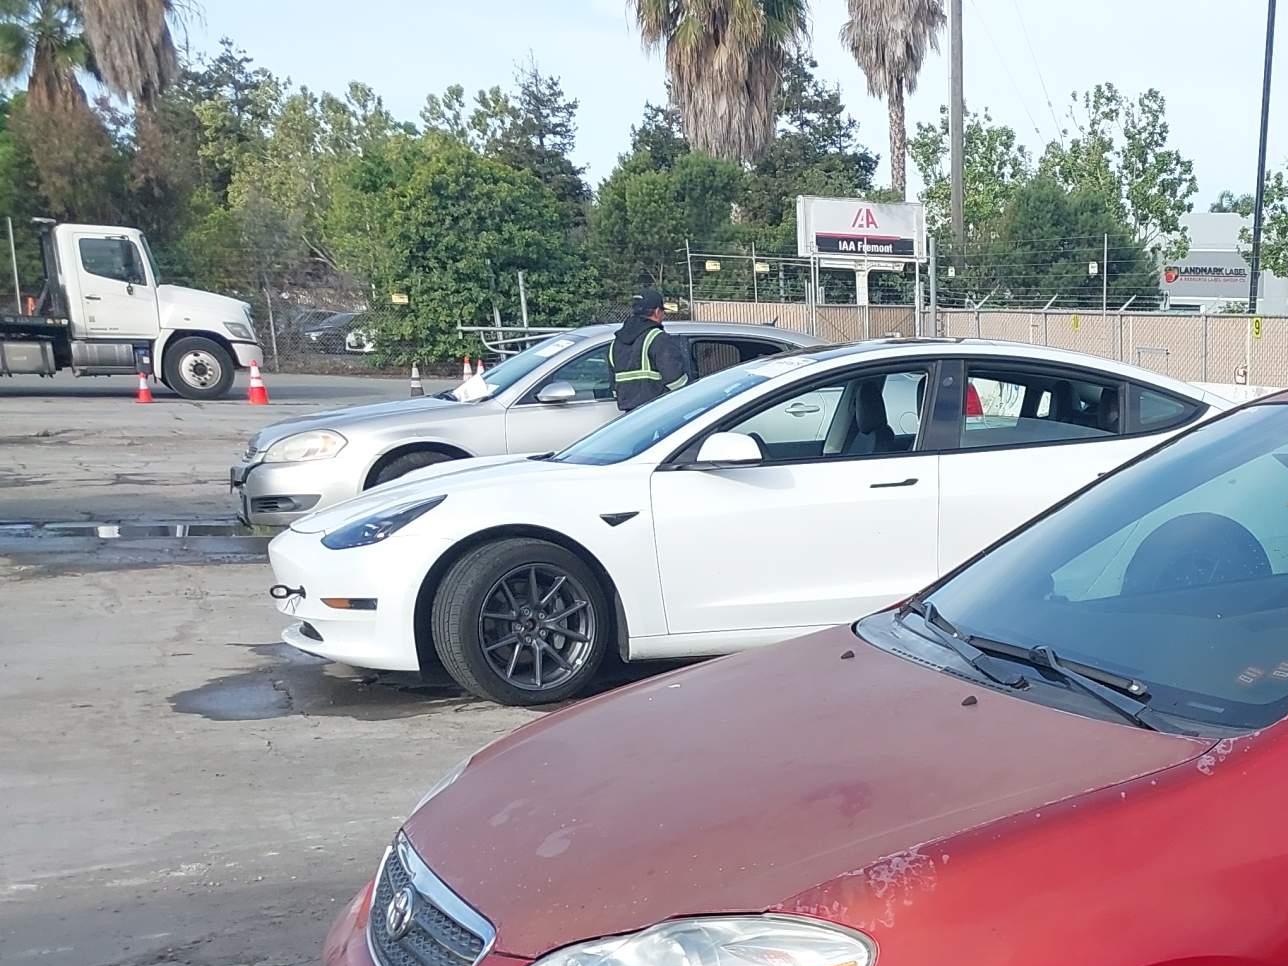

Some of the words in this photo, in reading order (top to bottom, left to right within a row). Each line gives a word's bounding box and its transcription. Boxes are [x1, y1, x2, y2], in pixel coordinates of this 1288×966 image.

[838, 240, 856, 252] IAA
[857, 241, 893, 254] Fremont
[1180, 266, 1224, 276] LANDMARK
[1224, 267, 1248, 276] LABEL
[1254, 319, 1260, 335] 9
